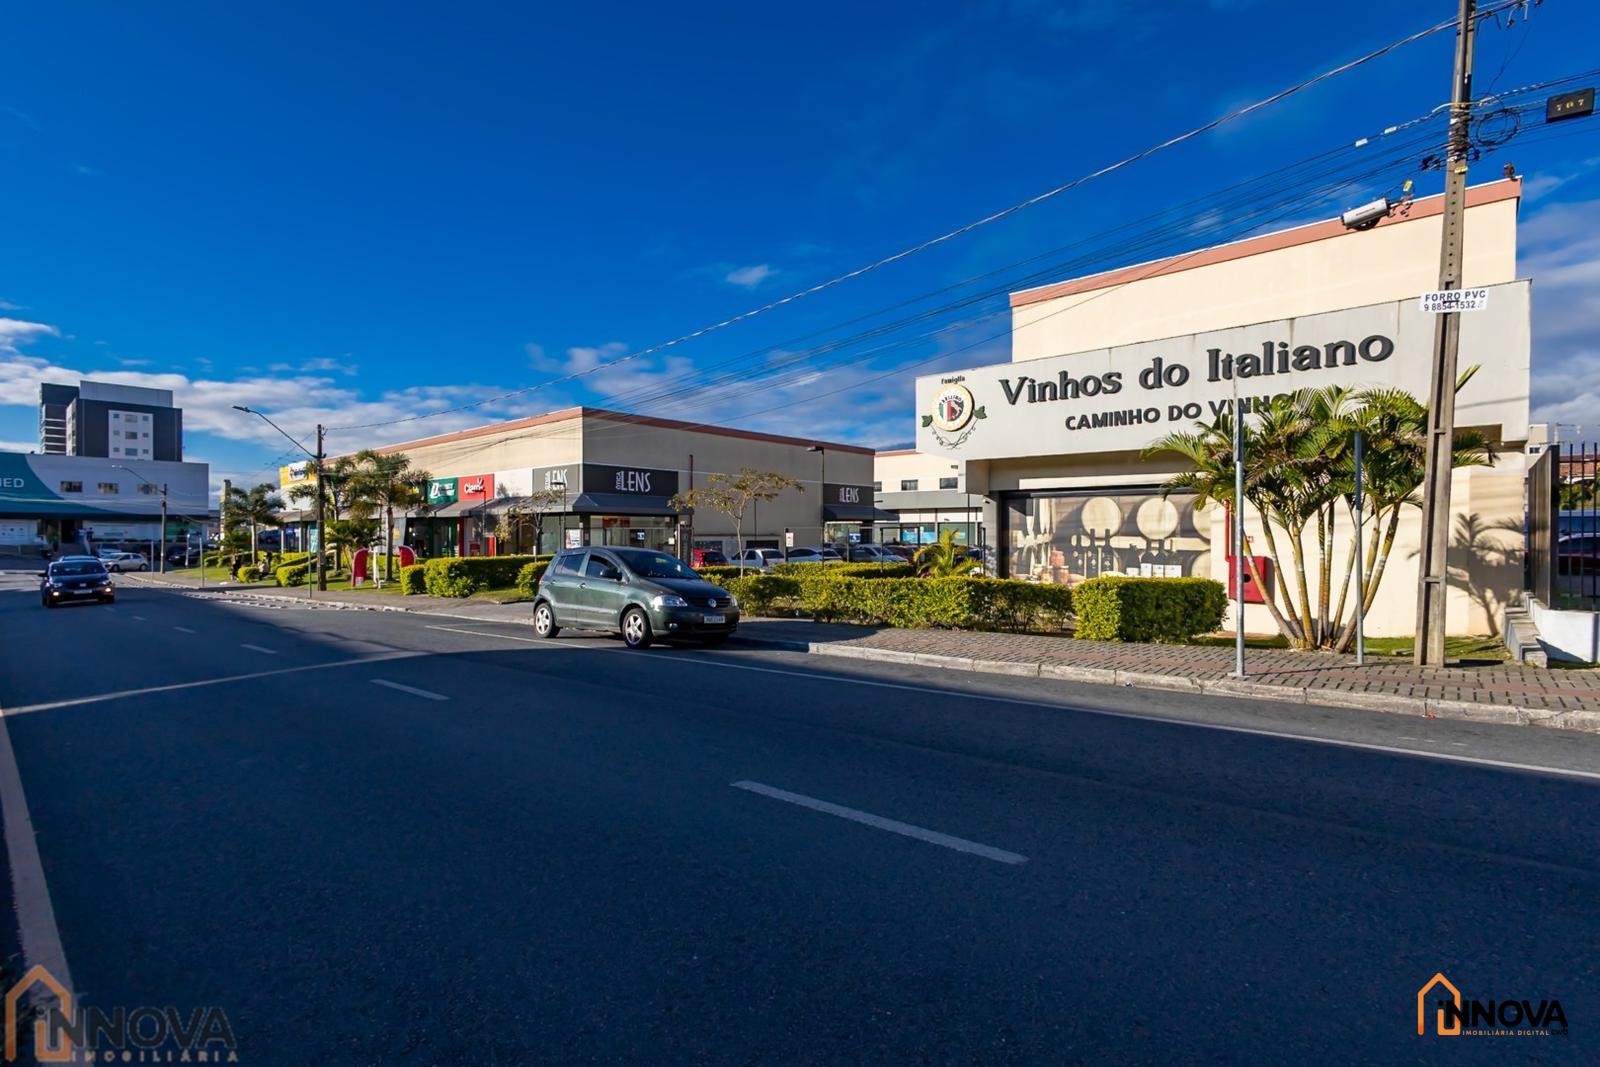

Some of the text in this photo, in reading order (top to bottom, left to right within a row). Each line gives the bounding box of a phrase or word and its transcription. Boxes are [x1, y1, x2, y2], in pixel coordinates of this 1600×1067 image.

[1425, 290, 1486, 302] FORRO PVC
[1423, 303, 1430, 312] 9
[999, 334, 1395, 406] Vinhos do Italiano
[1065, 407, 1161, 430] CAMINHO
[1167, 402, 1203, 422] DO
[0, 477, 25, 488] ED
[621, 470, 651, 493] LENS
[842, 487, 860, 503] LENS
